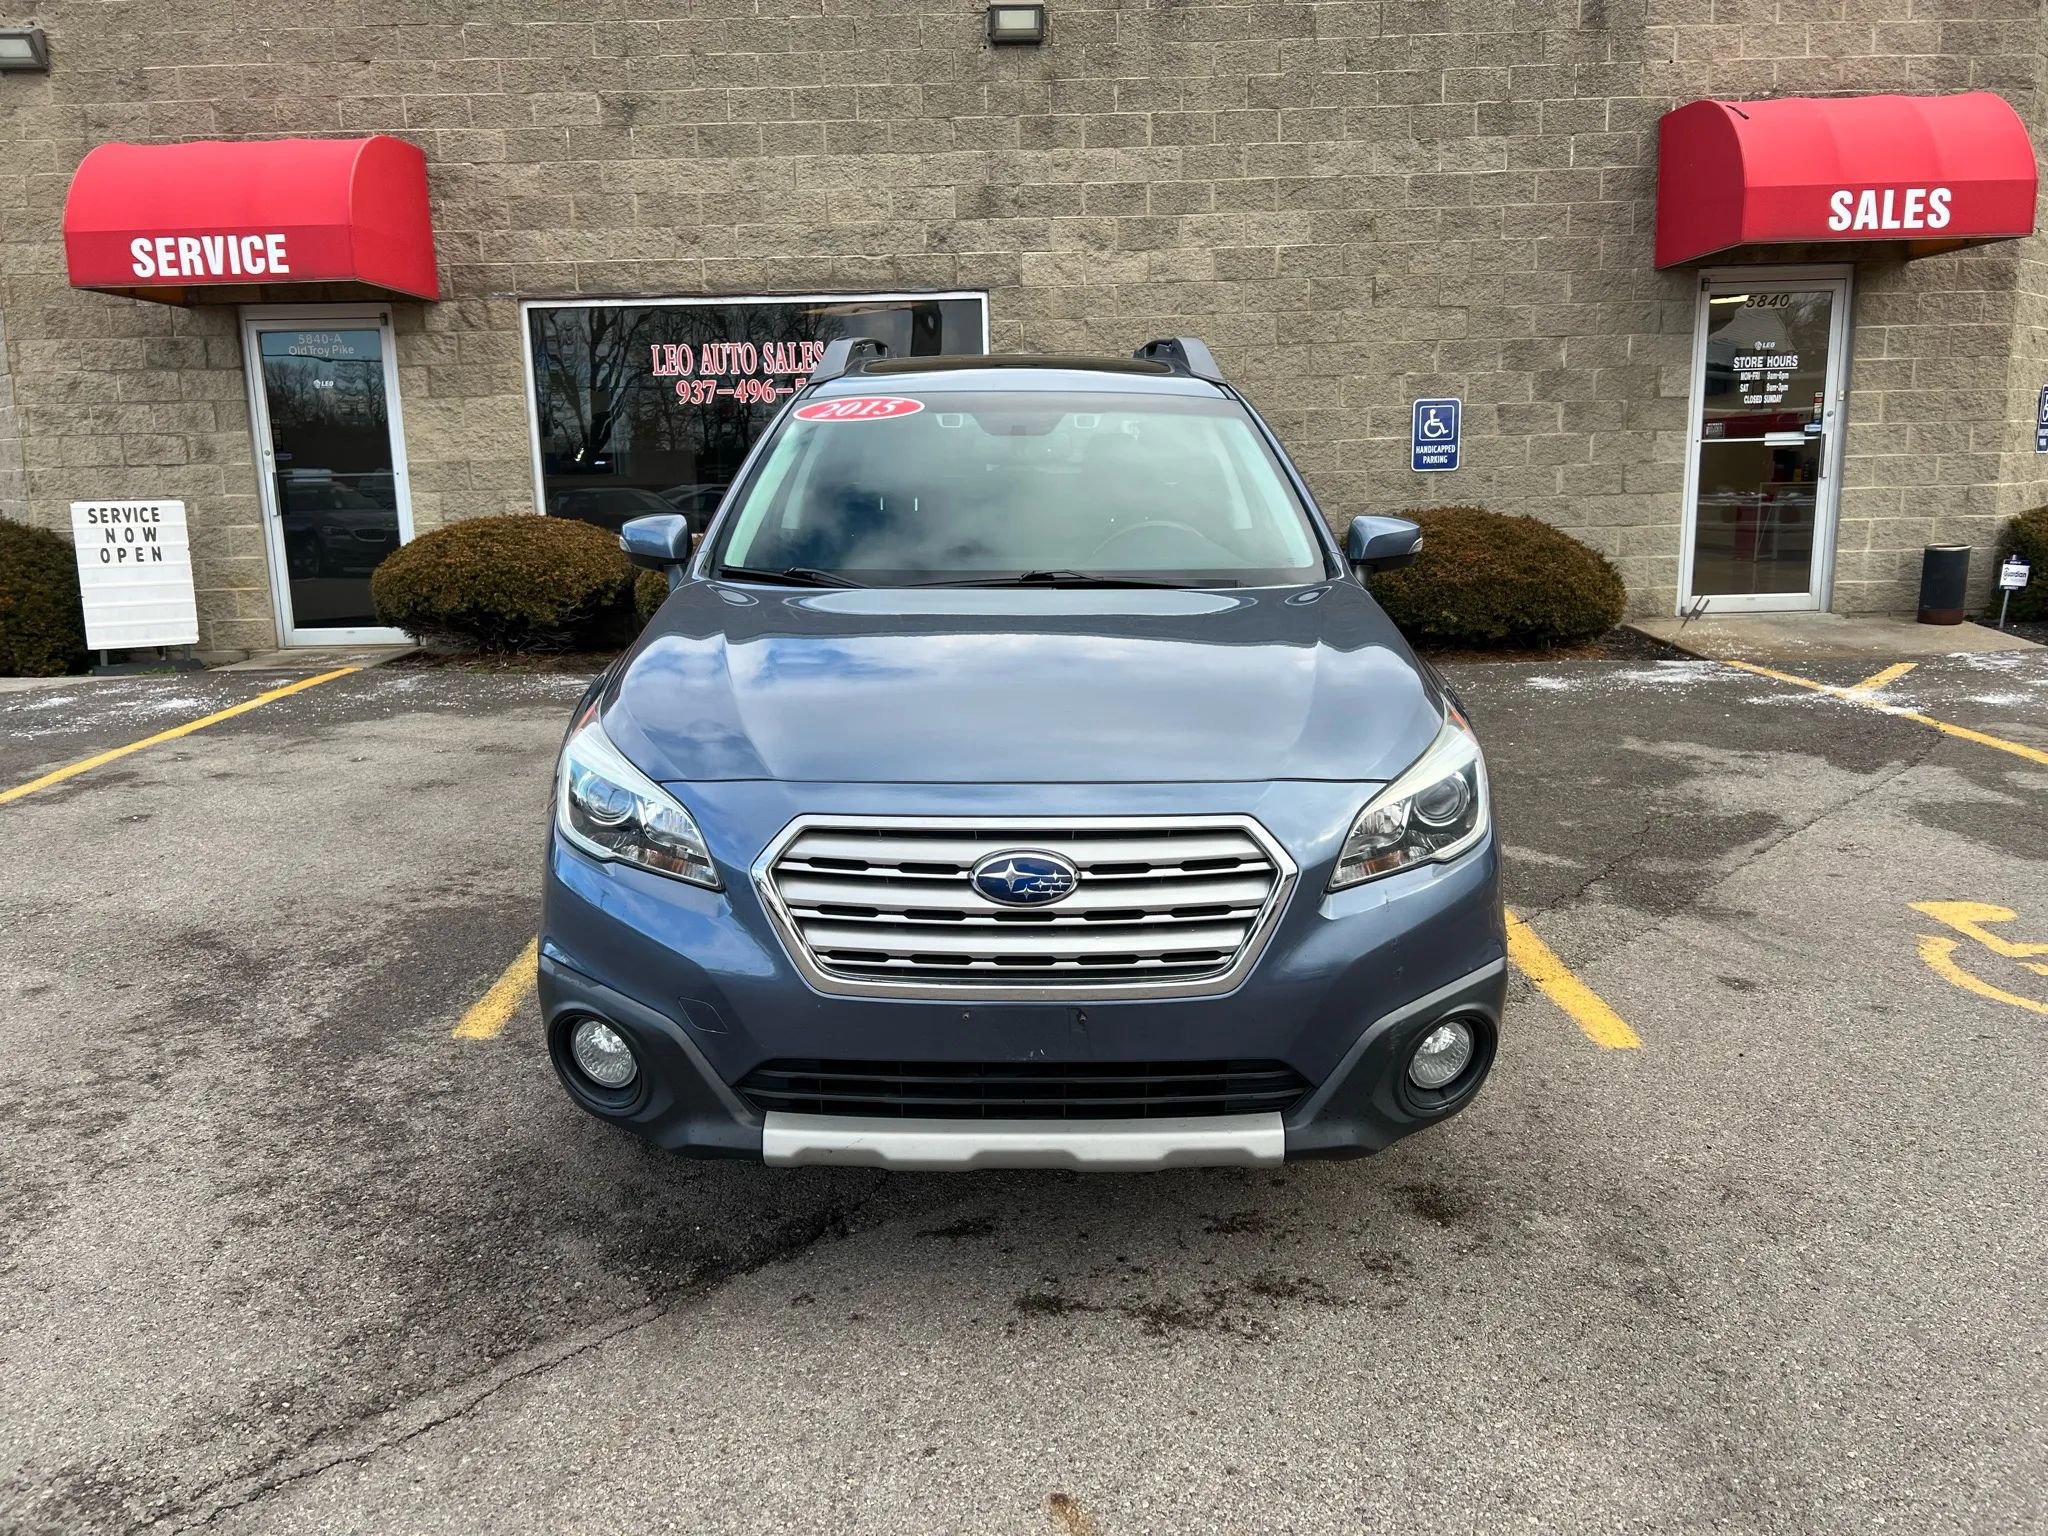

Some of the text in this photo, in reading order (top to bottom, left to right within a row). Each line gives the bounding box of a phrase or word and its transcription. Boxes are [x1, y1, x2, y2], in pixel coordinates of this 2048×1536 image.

[1828, 187, 1952, 231] SALES
[130, 233, 290, 278] SERVICE
[1746, 294, 1790, 308] 5840
[298, 334, 342, 345] 5840-A
[288, 344, 355, 357] Old Troy Pike
[650, 341, 824, 376] LEO AUTO SALES
[1733, 355, 1799, 368] STORE HOURS
[1740, 371, 1761, 381] MON-FRI
[1740, 383, 1750, 393] SAT
[1743, 394, 1783, 404] CLOSED SUNDAY
[818, 400, 899, 418] 2015
[1415, 444, 1456, 453] HANDICAPPED
[1422, 455, 1448, 464] PARKING
[88, 507, 161, 524] SERVICE
[105, 526, 157, 543] NOW
[100, 546, 162, 563] OPEN
